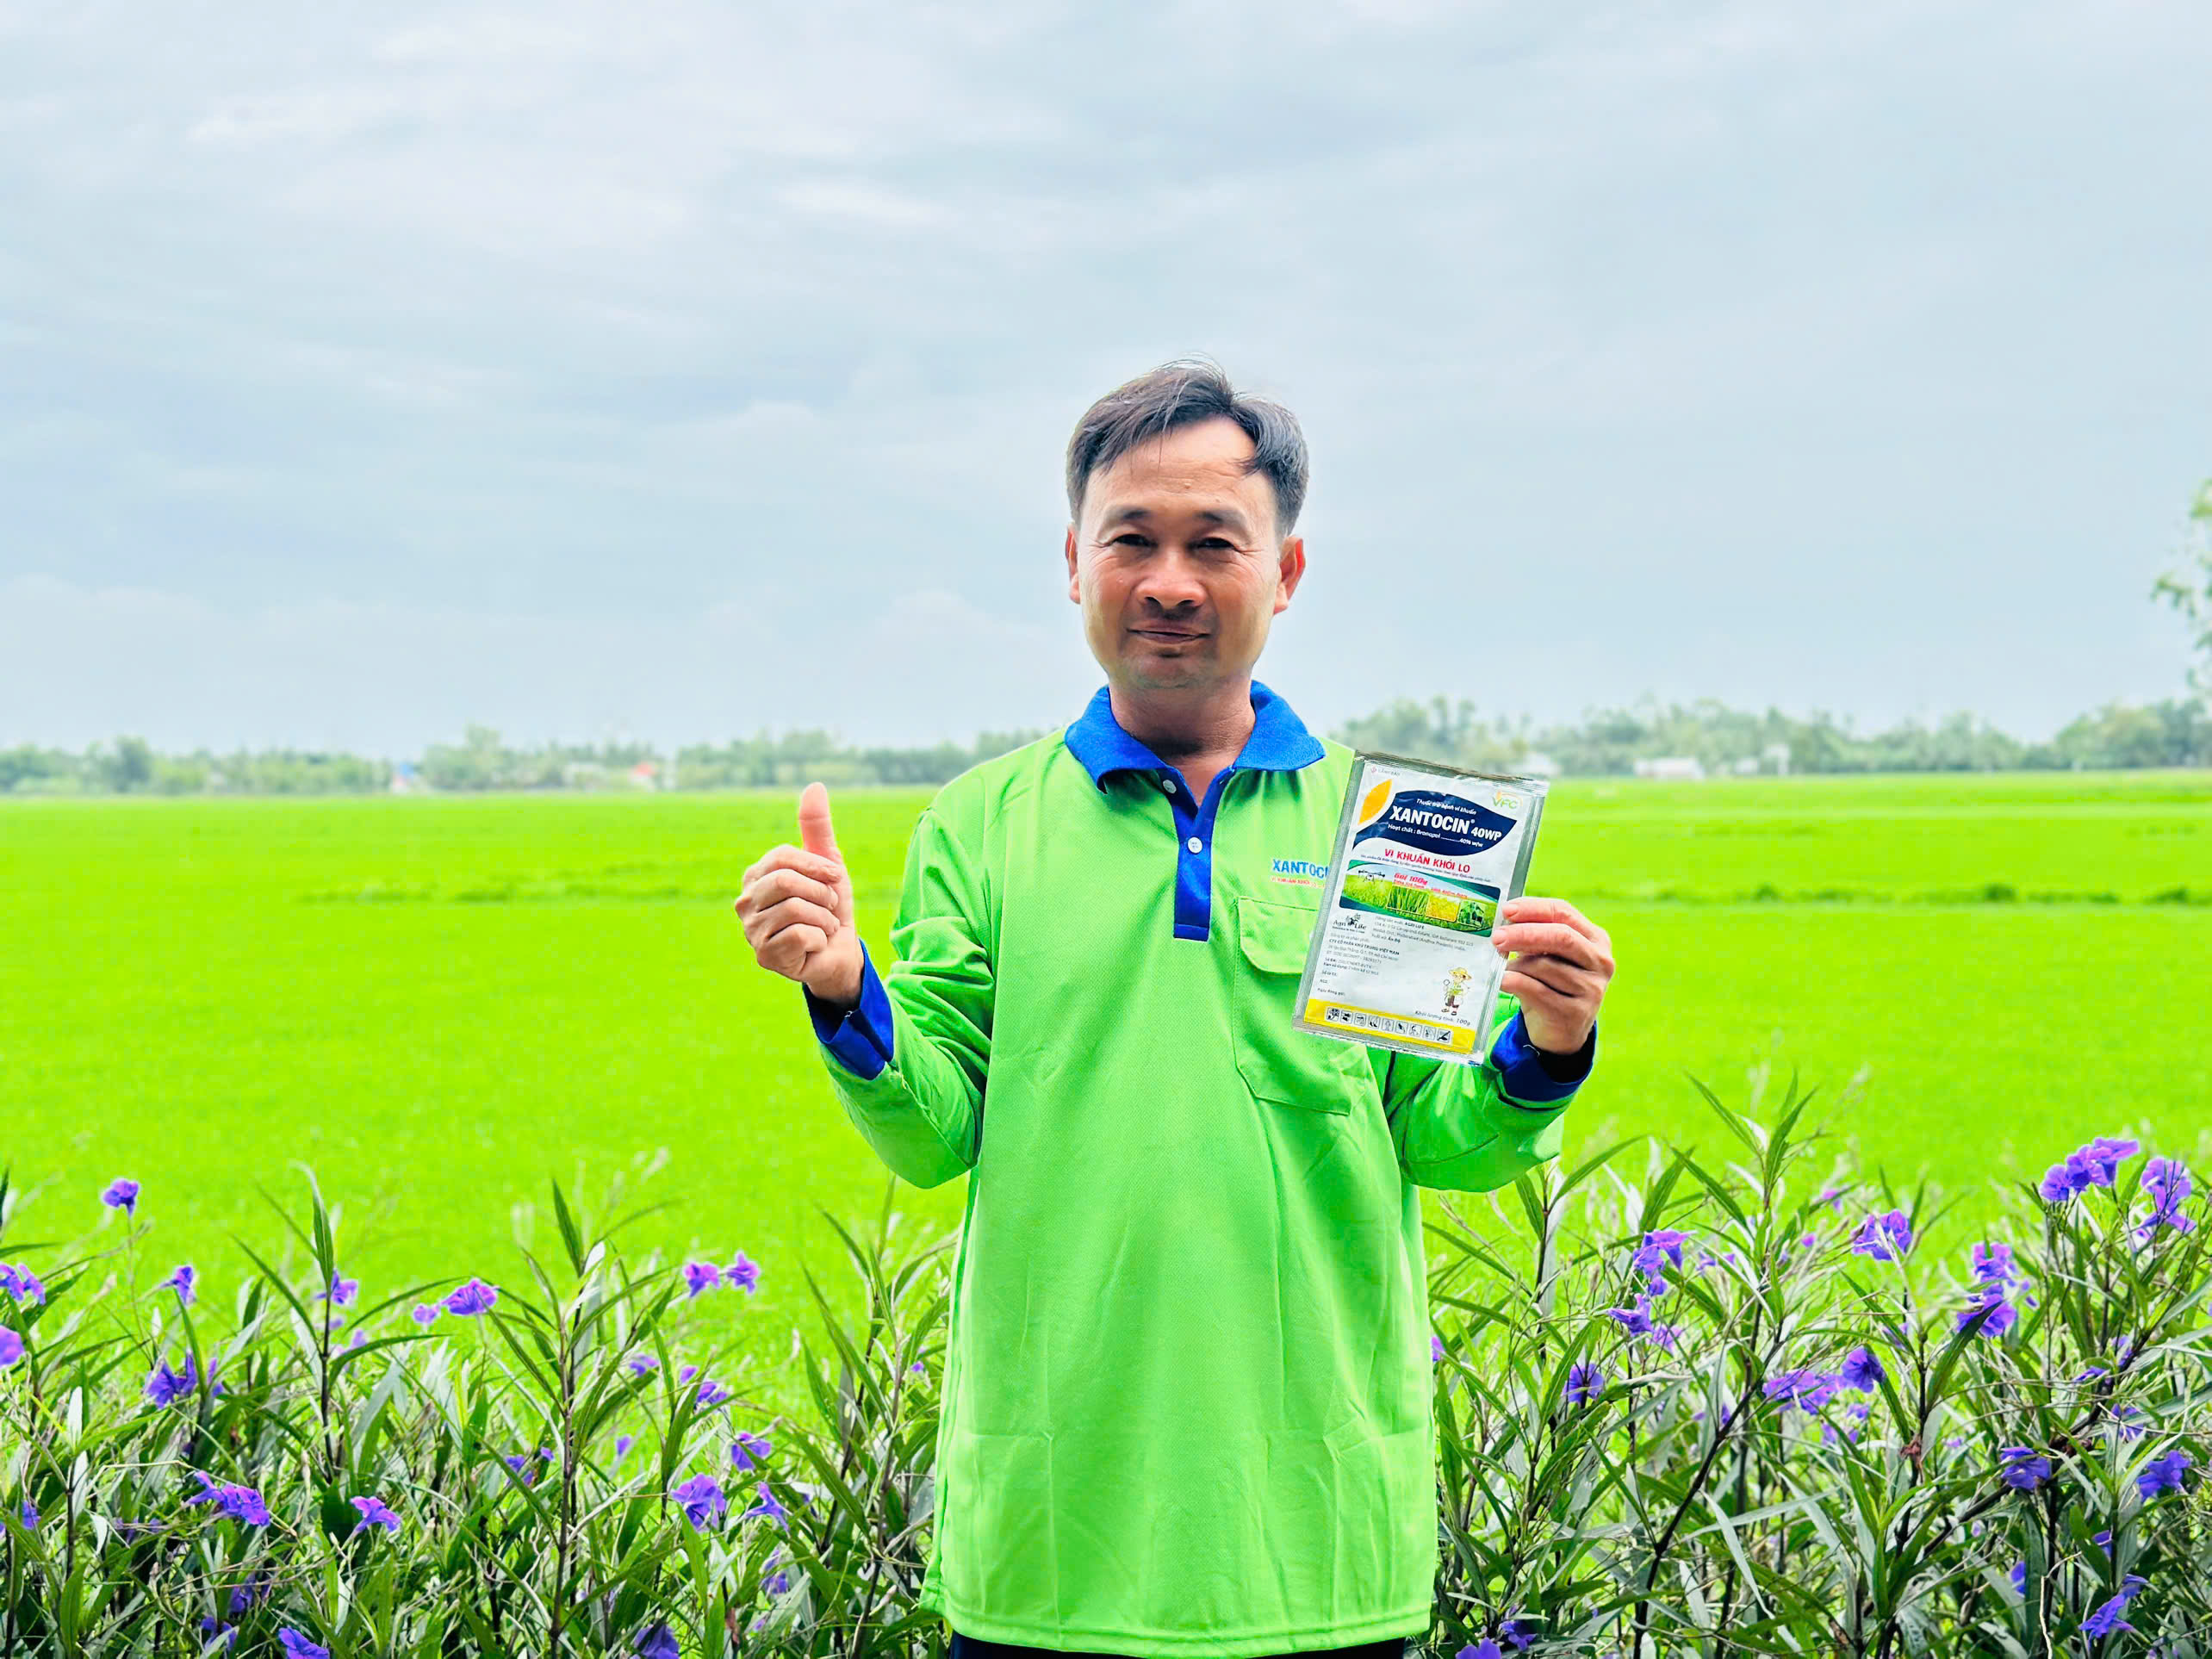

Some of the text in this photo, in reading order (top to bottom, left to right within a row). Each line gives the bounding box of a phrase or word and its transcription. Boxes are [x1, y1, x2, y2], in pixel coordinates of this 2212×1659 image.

[1492, 797, 1518, 809] VFC
[1389, 805, 1502, 841] XANTOCIN 40WP
[1273, 859, 1328, 879] XANTOCI
[1385, 848, 1394, 857] VI
[1458, 864, 1470, 873] LO
